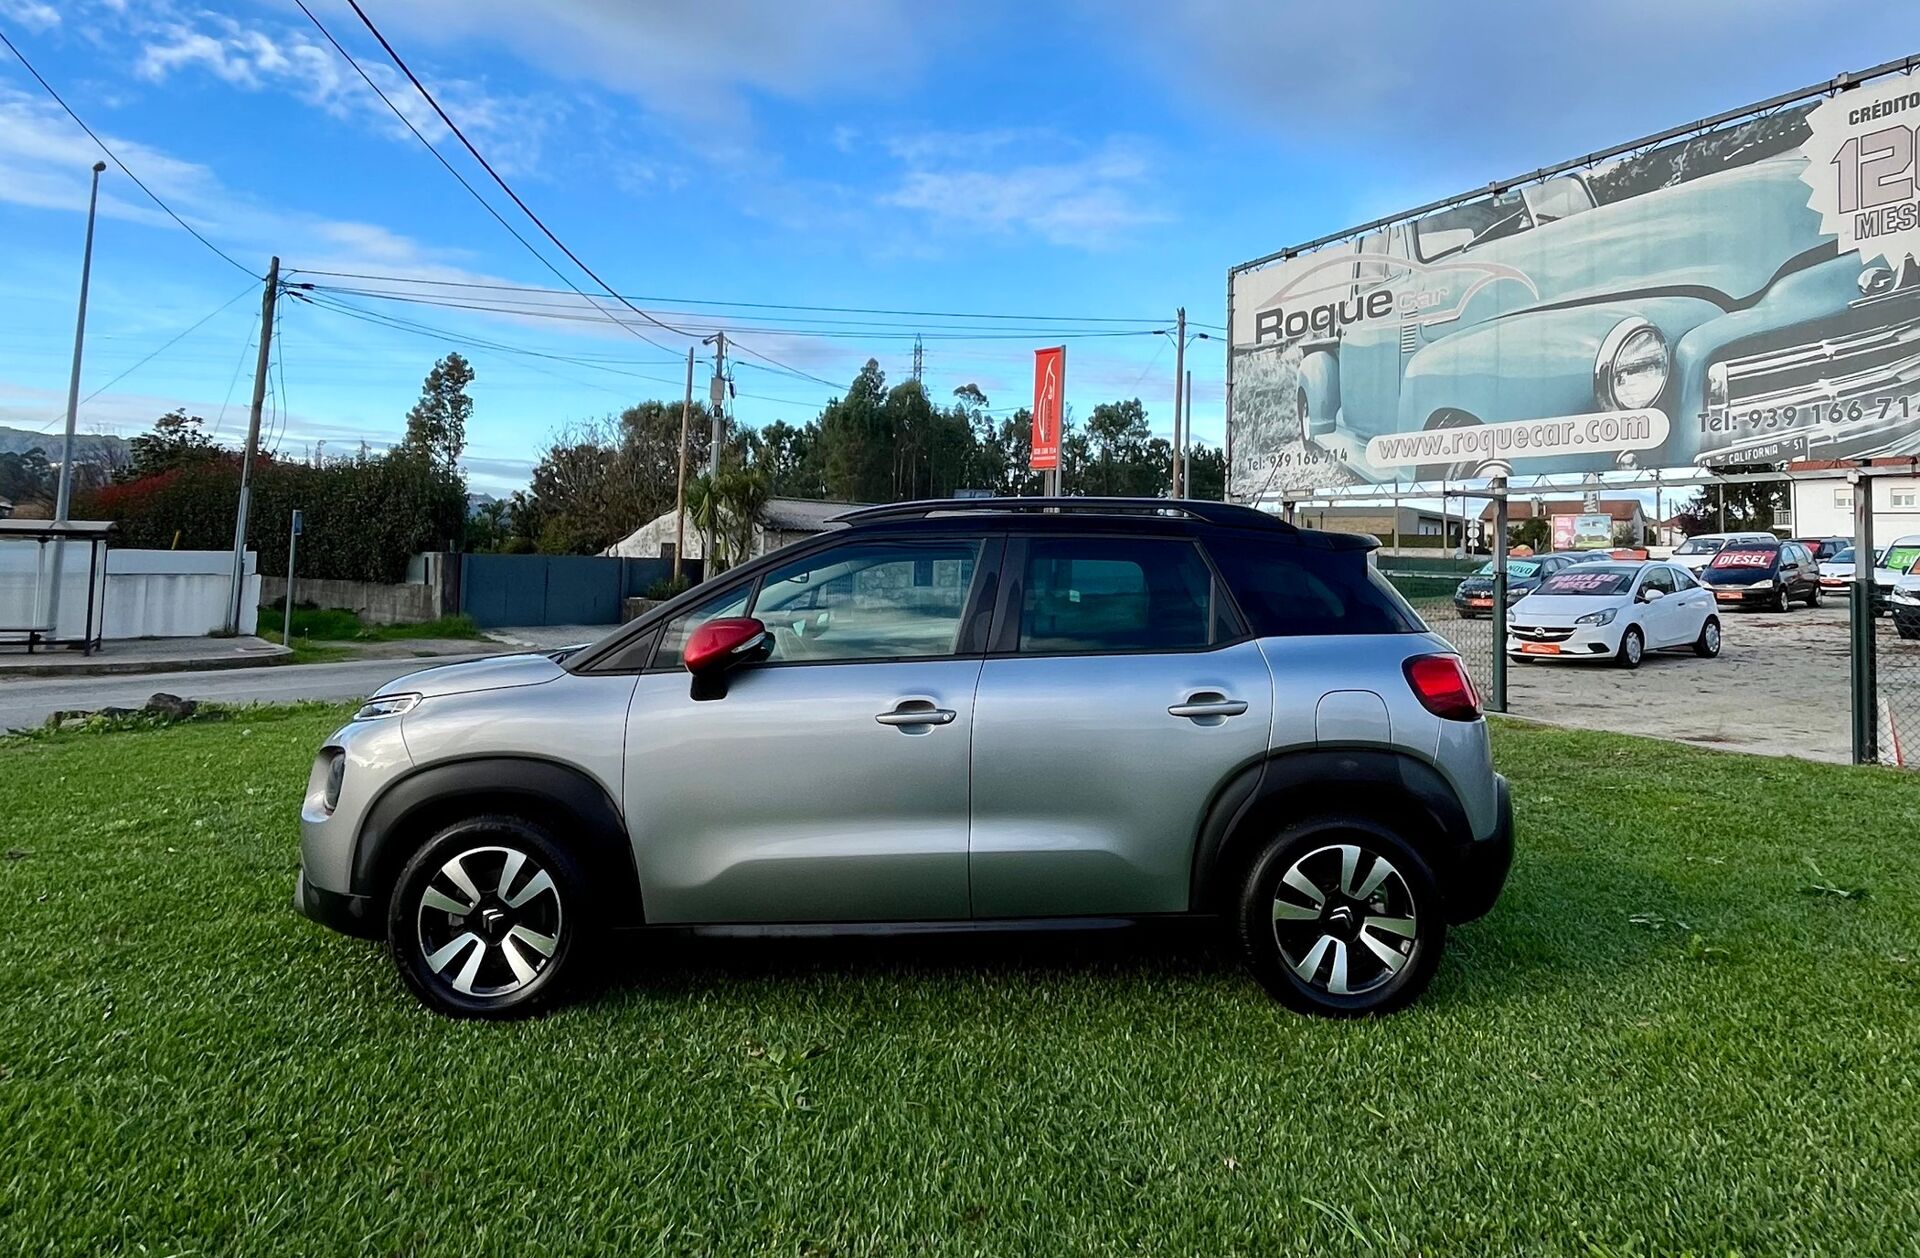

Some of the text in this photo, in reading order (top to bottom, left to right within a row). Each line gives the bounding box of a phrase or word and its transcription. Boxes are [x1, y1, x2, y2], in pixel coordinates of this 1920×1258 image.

[1849, 92, 1920, 125] CRÉDITO
[1830, 124, 1920, 215] 12
[1855, 201, 1920, 241] MES
[1255, 289, 1393, 345] Roque
[1697, 396, 1920, 433] Tel: 939 166 71
[1378, 414, 1651, 460] www.roquecar.com
[1728, 444, 1779, 465] CALIFORNIA
[1247, 457, 1266, 471] Tel:
[1296, 451, 1319, 466] 166
[1324, 448, 1348, 464] 714
[1508, 564, 1533, 575] NOVO
[1718, 554, 1768, 566] DIESEL
